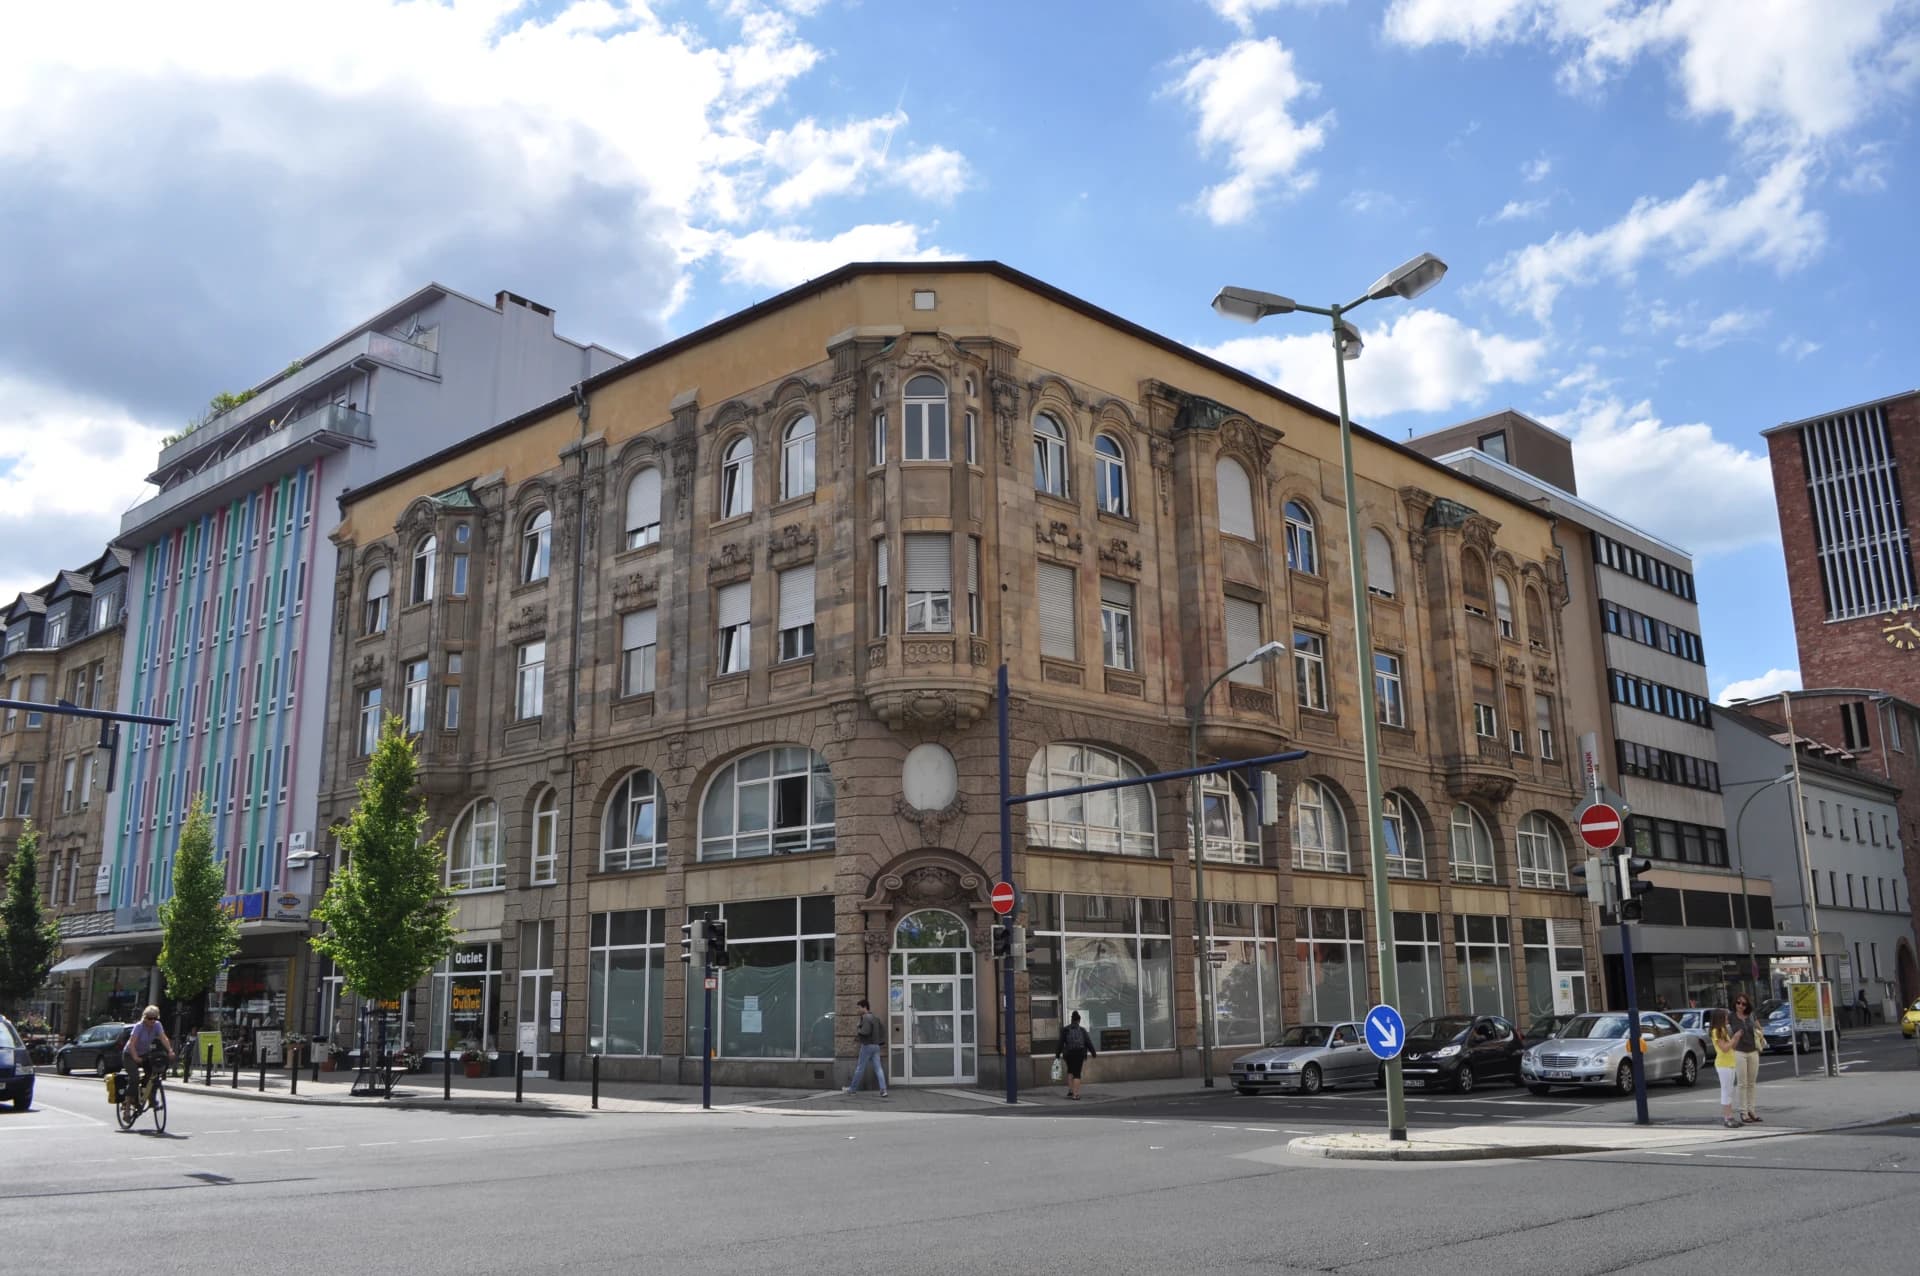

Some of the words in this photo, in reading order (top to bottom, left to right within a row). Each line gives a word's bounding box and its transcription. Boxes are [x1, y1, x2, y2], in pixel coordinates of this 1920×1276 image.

[455, 952, 483, 964] Outlet
[453, 986, 481, 996] Designer
[453, 997, 481, 1009] Outlet
